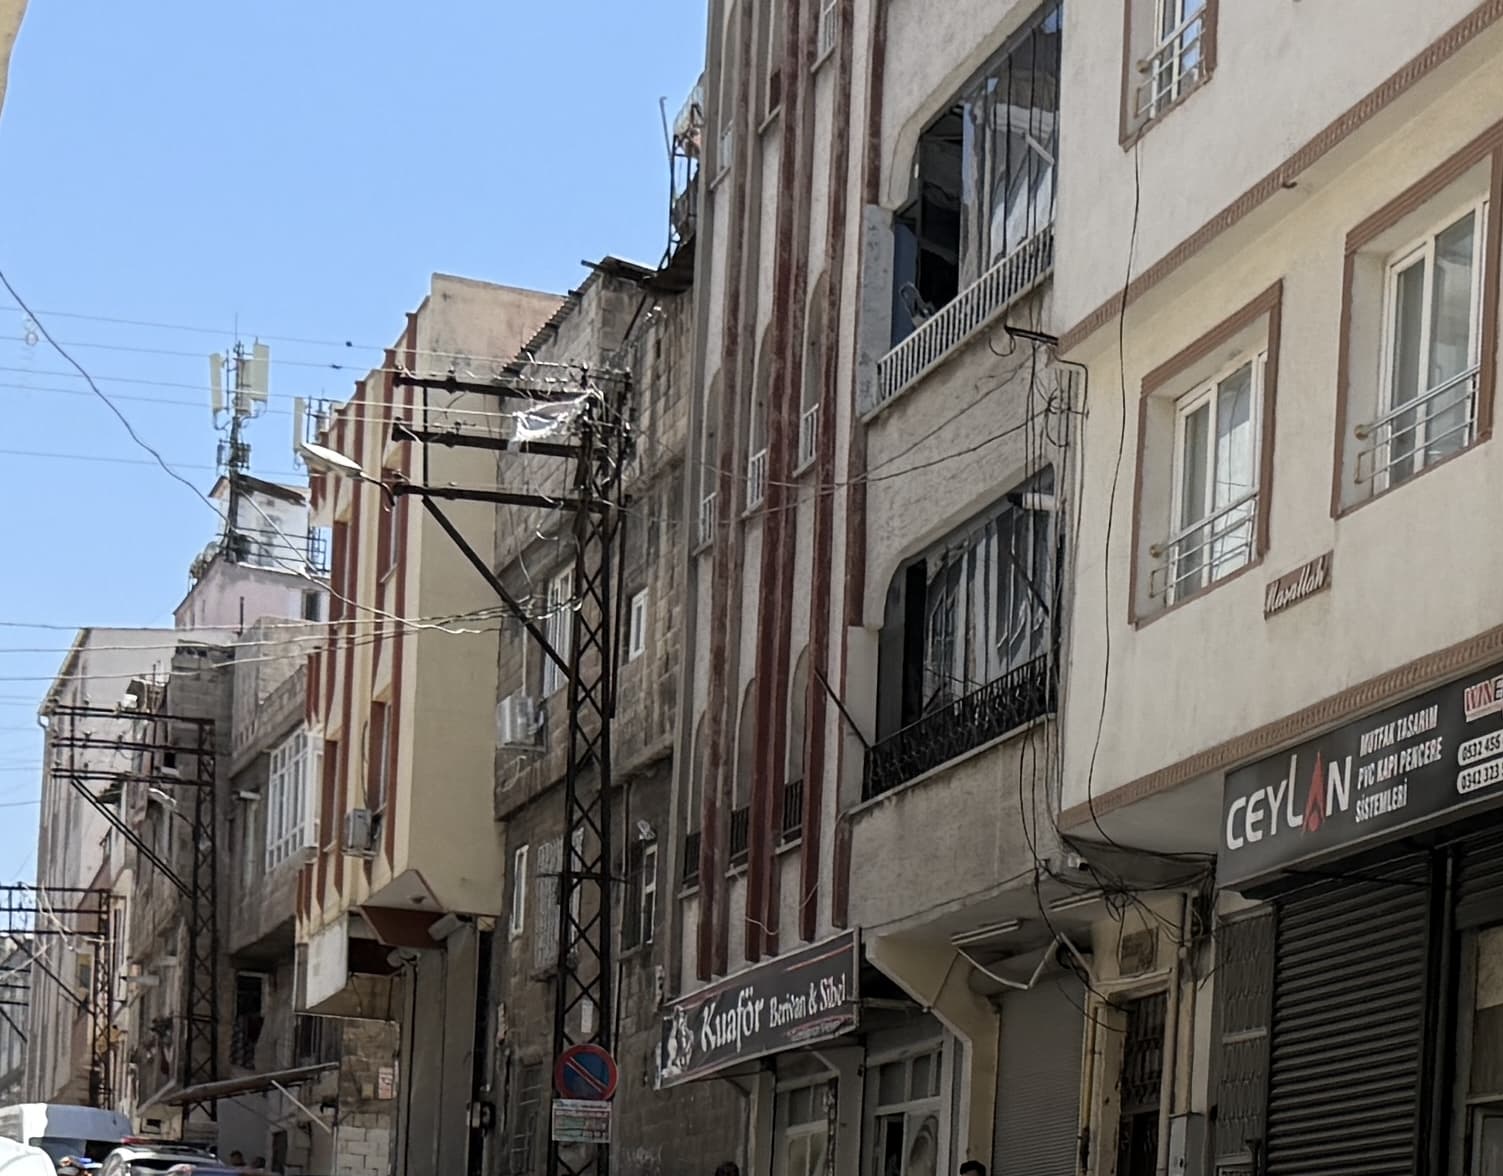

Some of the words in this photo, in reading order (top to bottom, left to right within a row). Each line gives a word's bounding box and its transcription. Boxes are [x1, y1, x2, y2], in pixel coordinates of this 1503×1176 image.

[1359, 721, 1396, 757] MUTFAK
[1397, 704, 1439, 742] TASARIM
[1357, 762, 1375, 790] PVC
[1376, 753, 1398, 782] KAPI
[1399, 736, 1443, 774] PENCERE
[1226, 750, 1352, 850] CEYLAN
[1355, 777, 1408, 823] SİSTEMLERİ
[701, 985, 765, 1052] Kuaför
